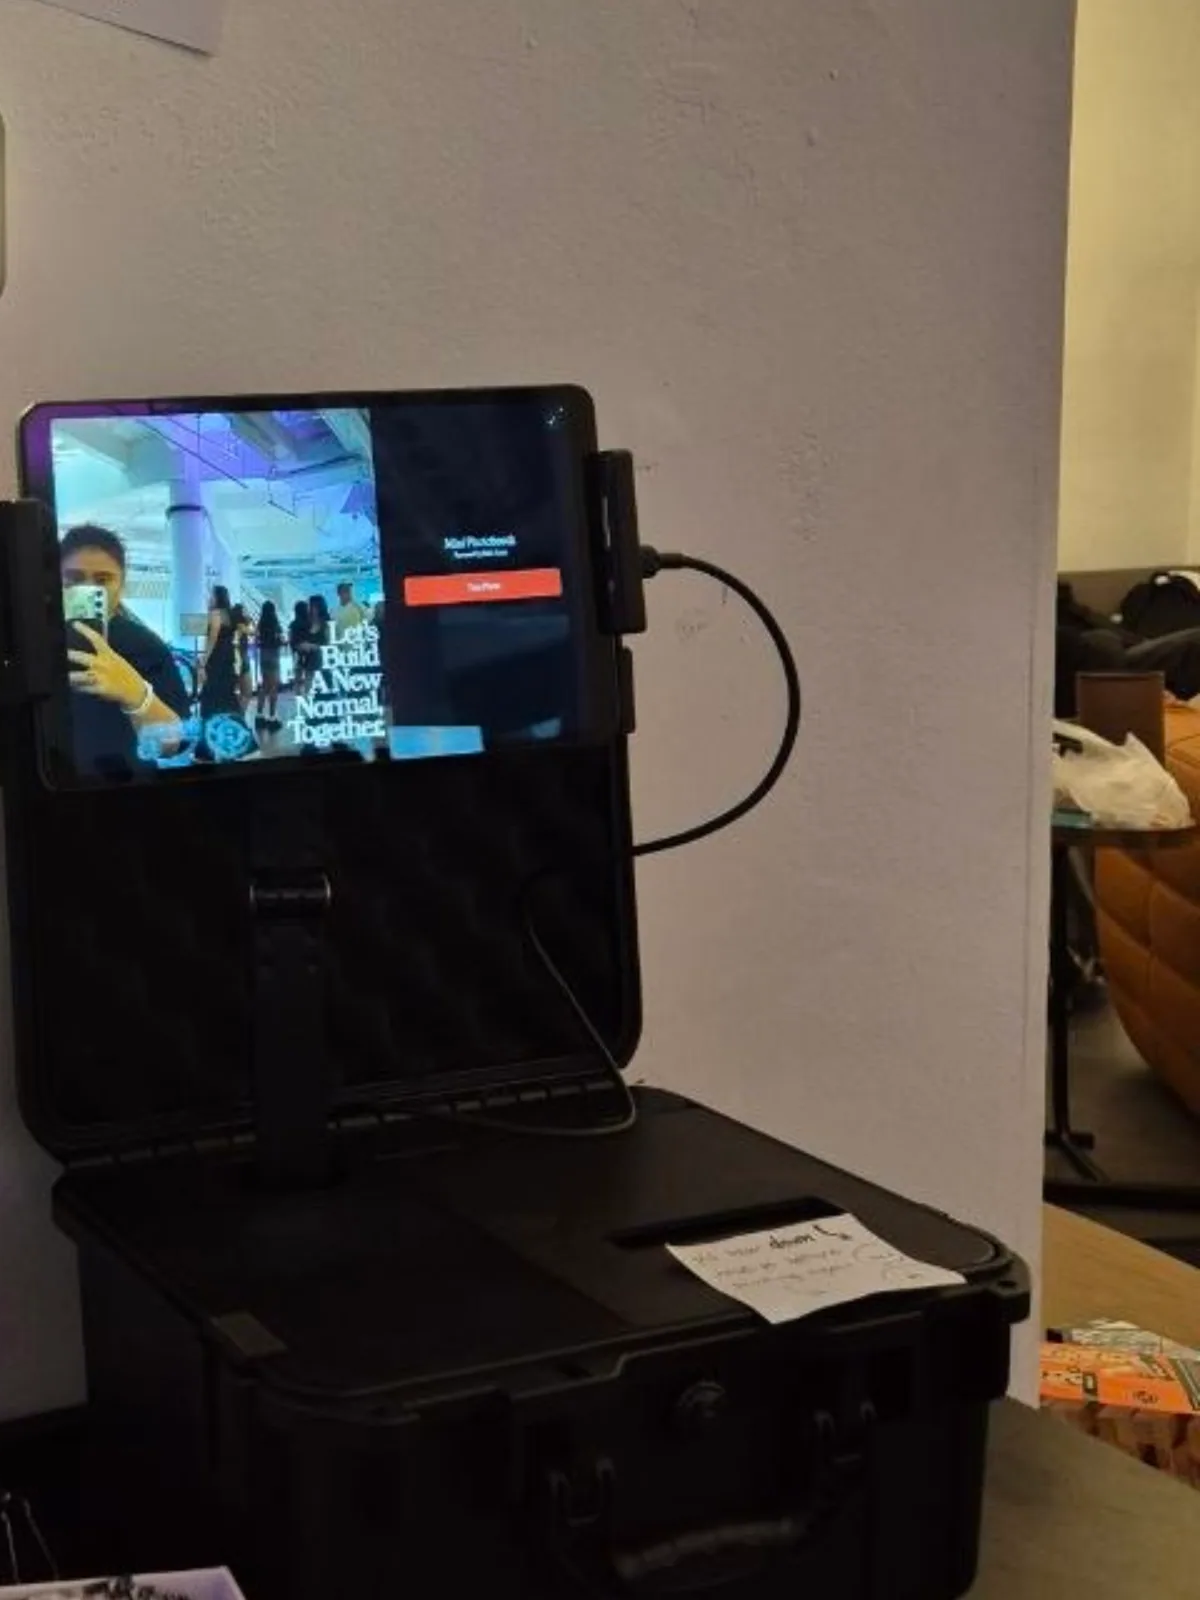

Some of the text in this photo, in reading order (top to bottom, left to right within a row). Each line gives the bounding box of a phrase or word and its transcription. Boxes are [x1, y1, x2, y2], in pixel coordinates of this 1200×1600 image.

[327, 619, 380, 645] Let's
[320, 643, 380, 670] Build
[309, 667, 383, 696] A New
